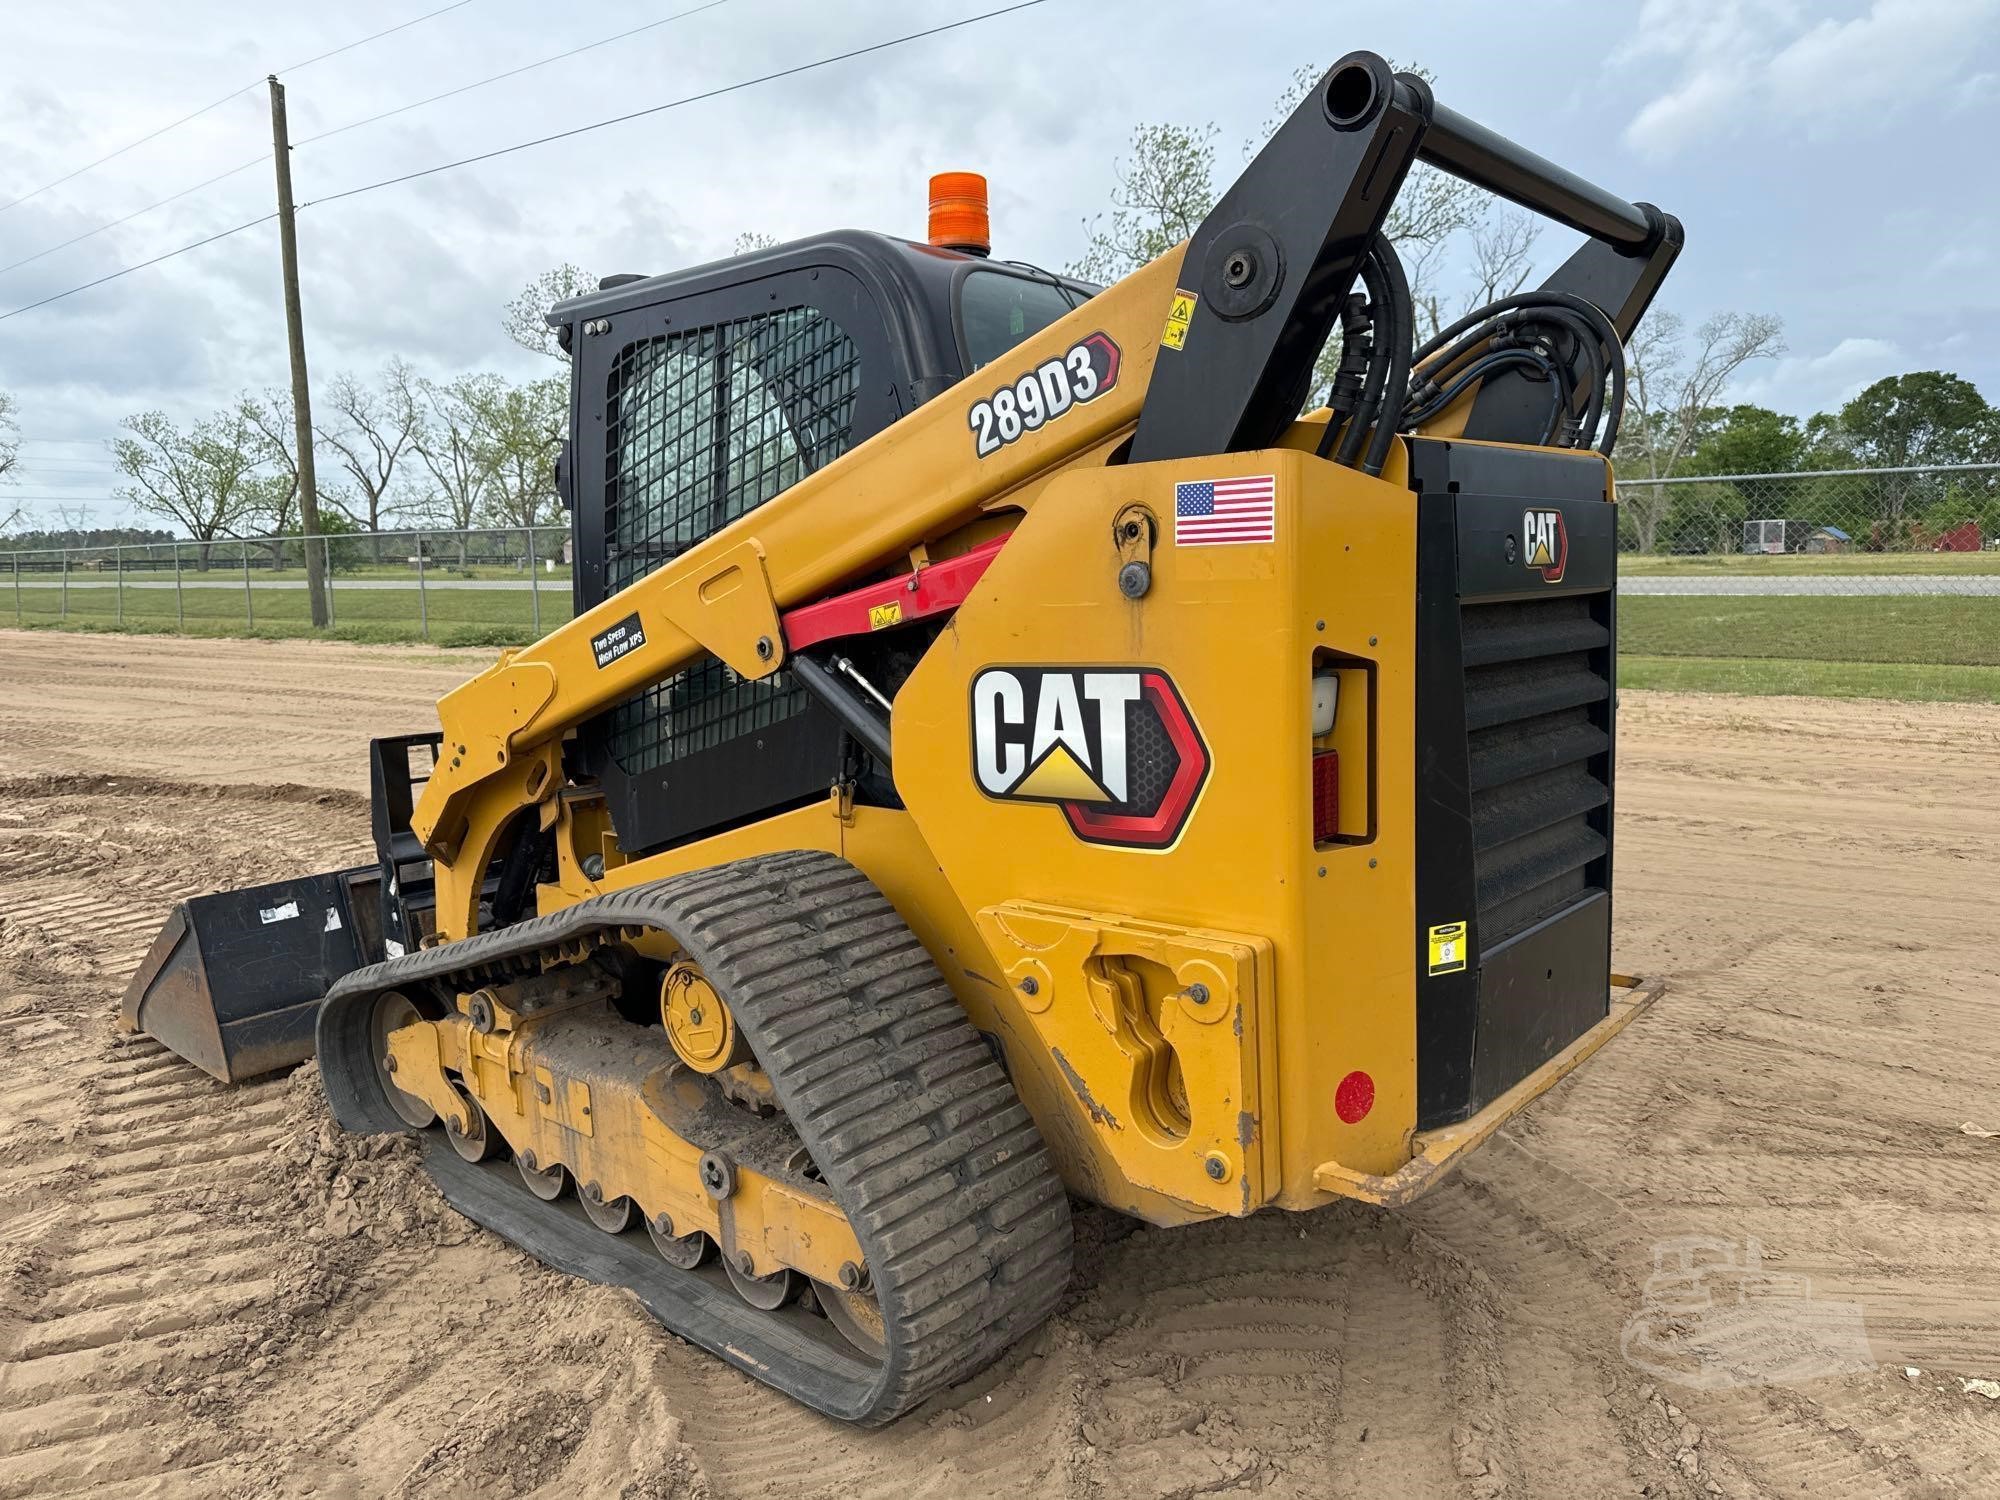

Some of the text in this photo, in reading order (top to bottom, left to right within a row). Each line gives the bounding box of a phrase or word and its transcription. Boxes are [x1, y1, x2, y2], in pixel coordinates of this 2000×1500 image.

[971, 345, 1098, 455] 289D3
[1524, 511, 1557, 565] CAT
[629, 631, 643, 647] XPS
[974, 670, 1141, 803] CAT
